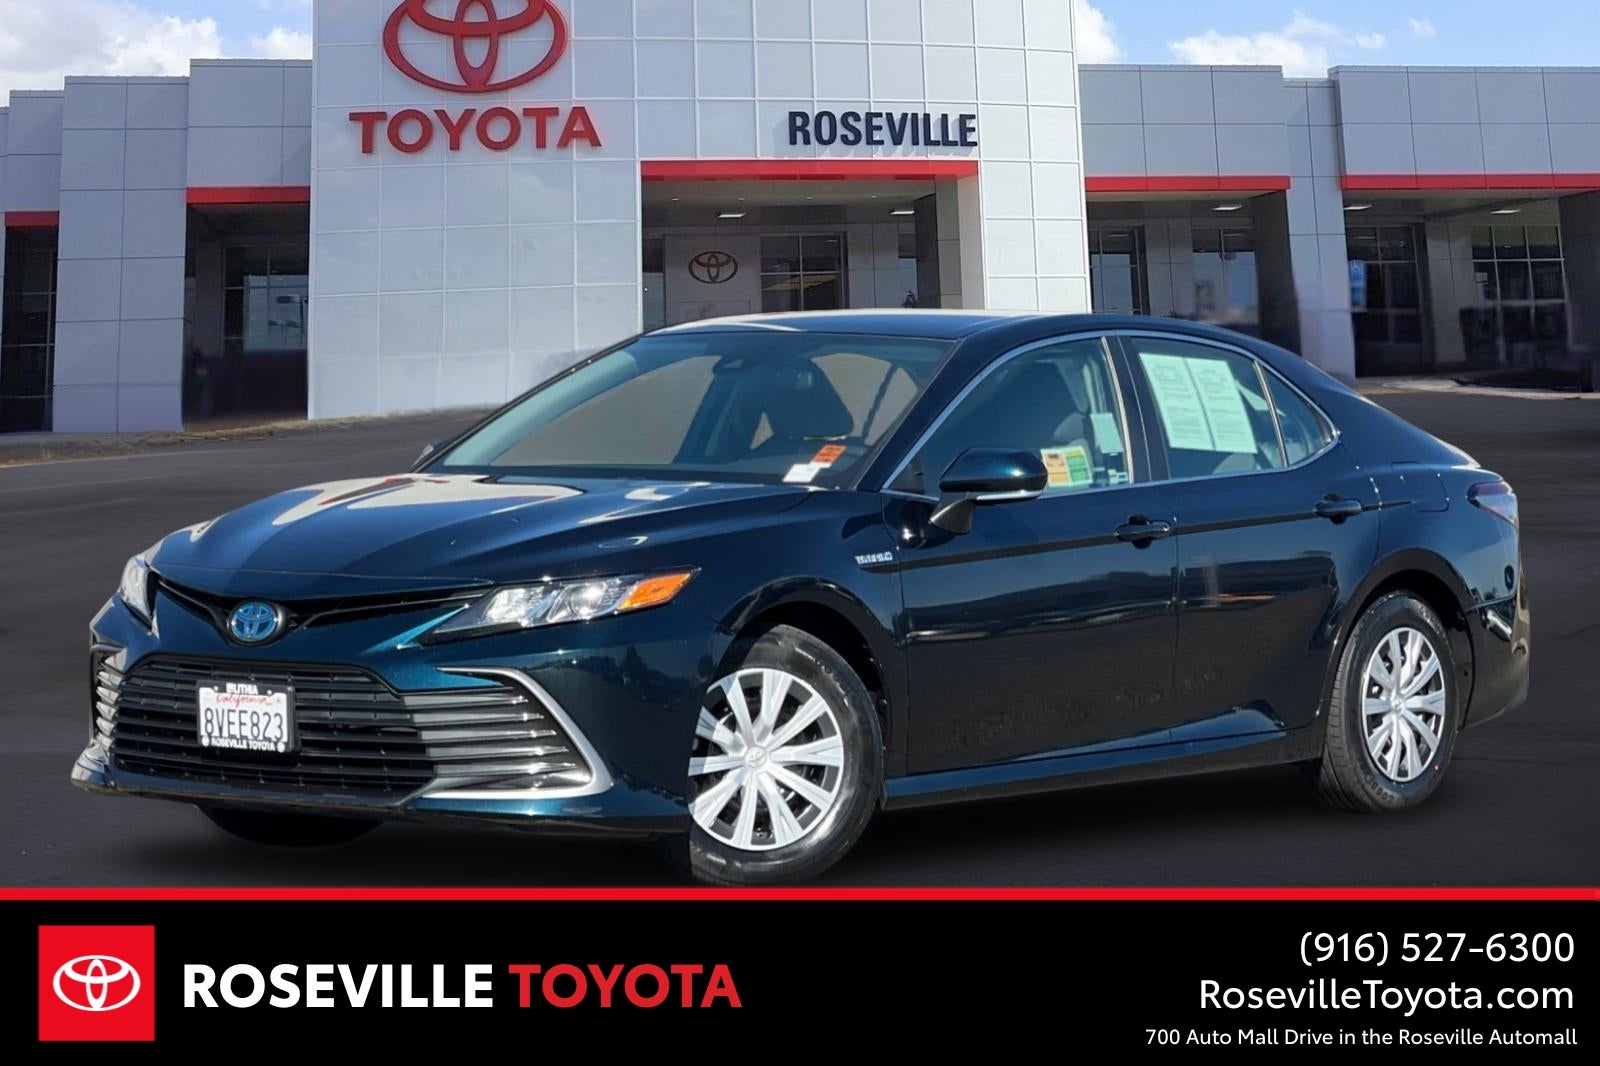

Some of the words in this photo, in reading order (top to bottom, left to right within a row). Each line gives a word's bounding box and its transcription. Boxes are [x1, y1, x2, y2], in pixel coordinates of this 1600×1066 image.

[349, 106, 602, 154] TOYOTA
[788, 110, 978, 146] ROSEVILLE
[205, 708, 283, 741] 8VEE823
[248, 740, 276, 751] TOYOTA
